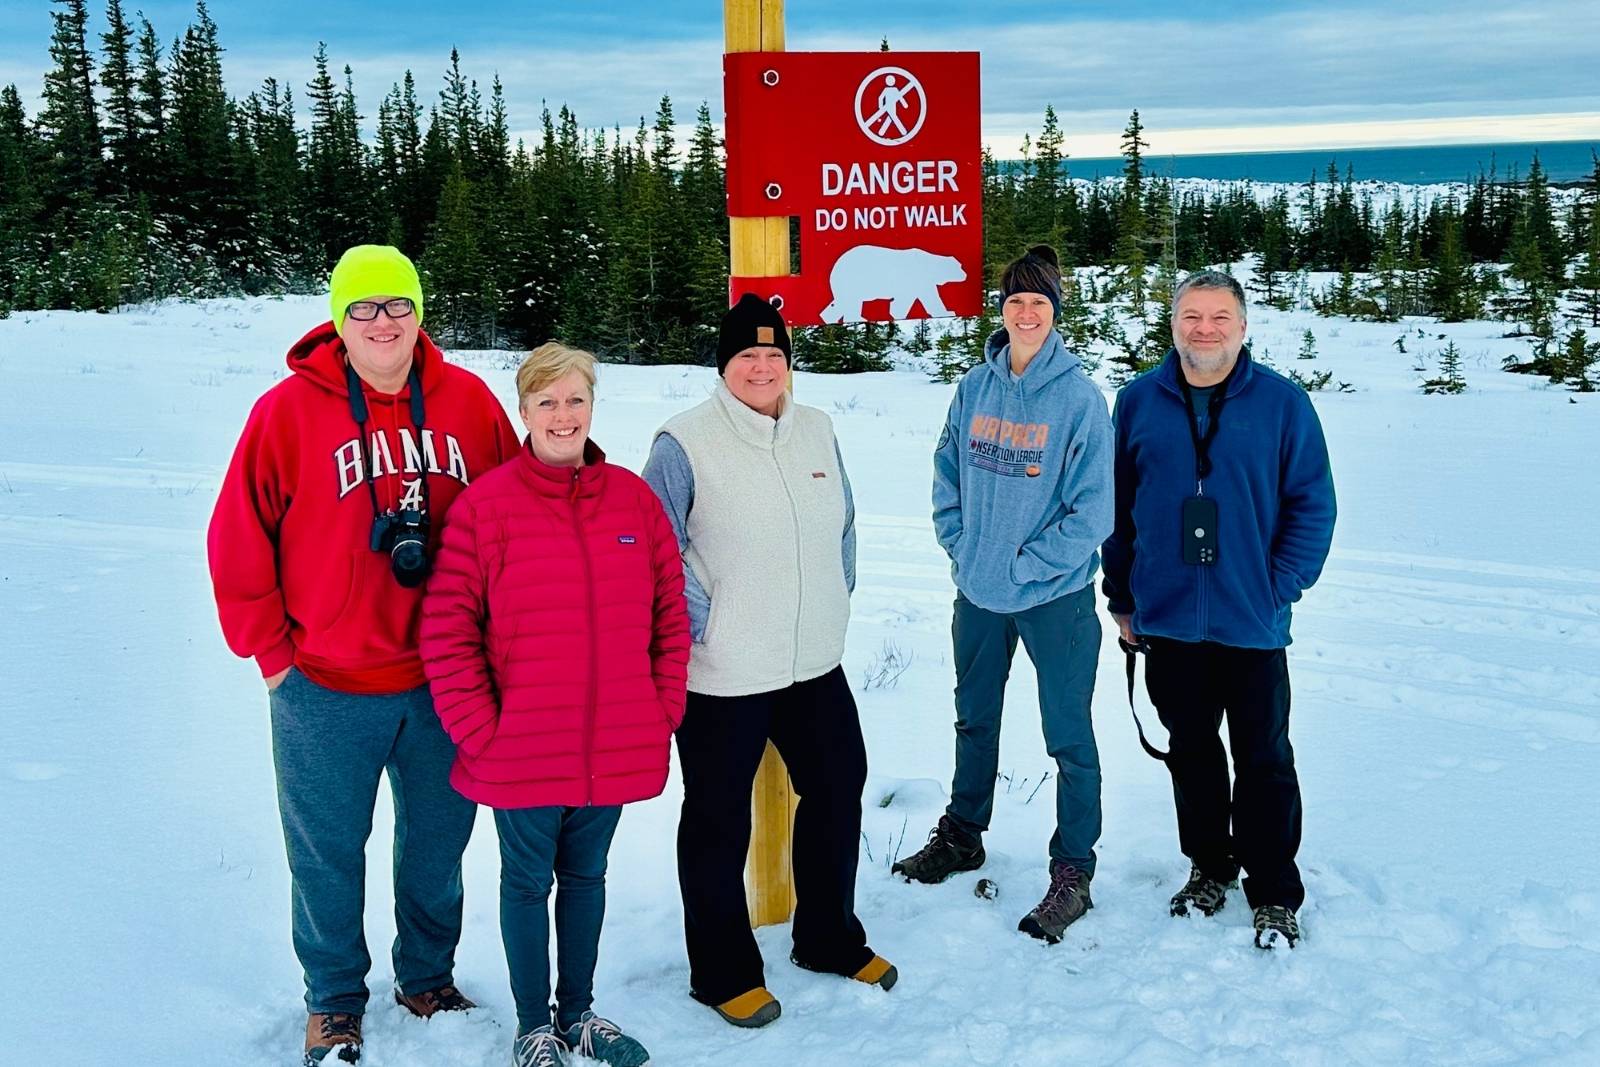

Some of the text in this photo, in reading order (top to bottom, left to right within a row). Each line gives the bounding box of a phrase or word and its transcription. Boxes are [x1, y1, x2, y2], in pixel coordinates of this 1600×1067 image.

[822, 160, 959, 196] DANGER
[815, 203, 967, 231] DO NOT WALK
[334, 428, 470, 499] BAMA
[1015, 449, 1044, 463] LEAGUE
